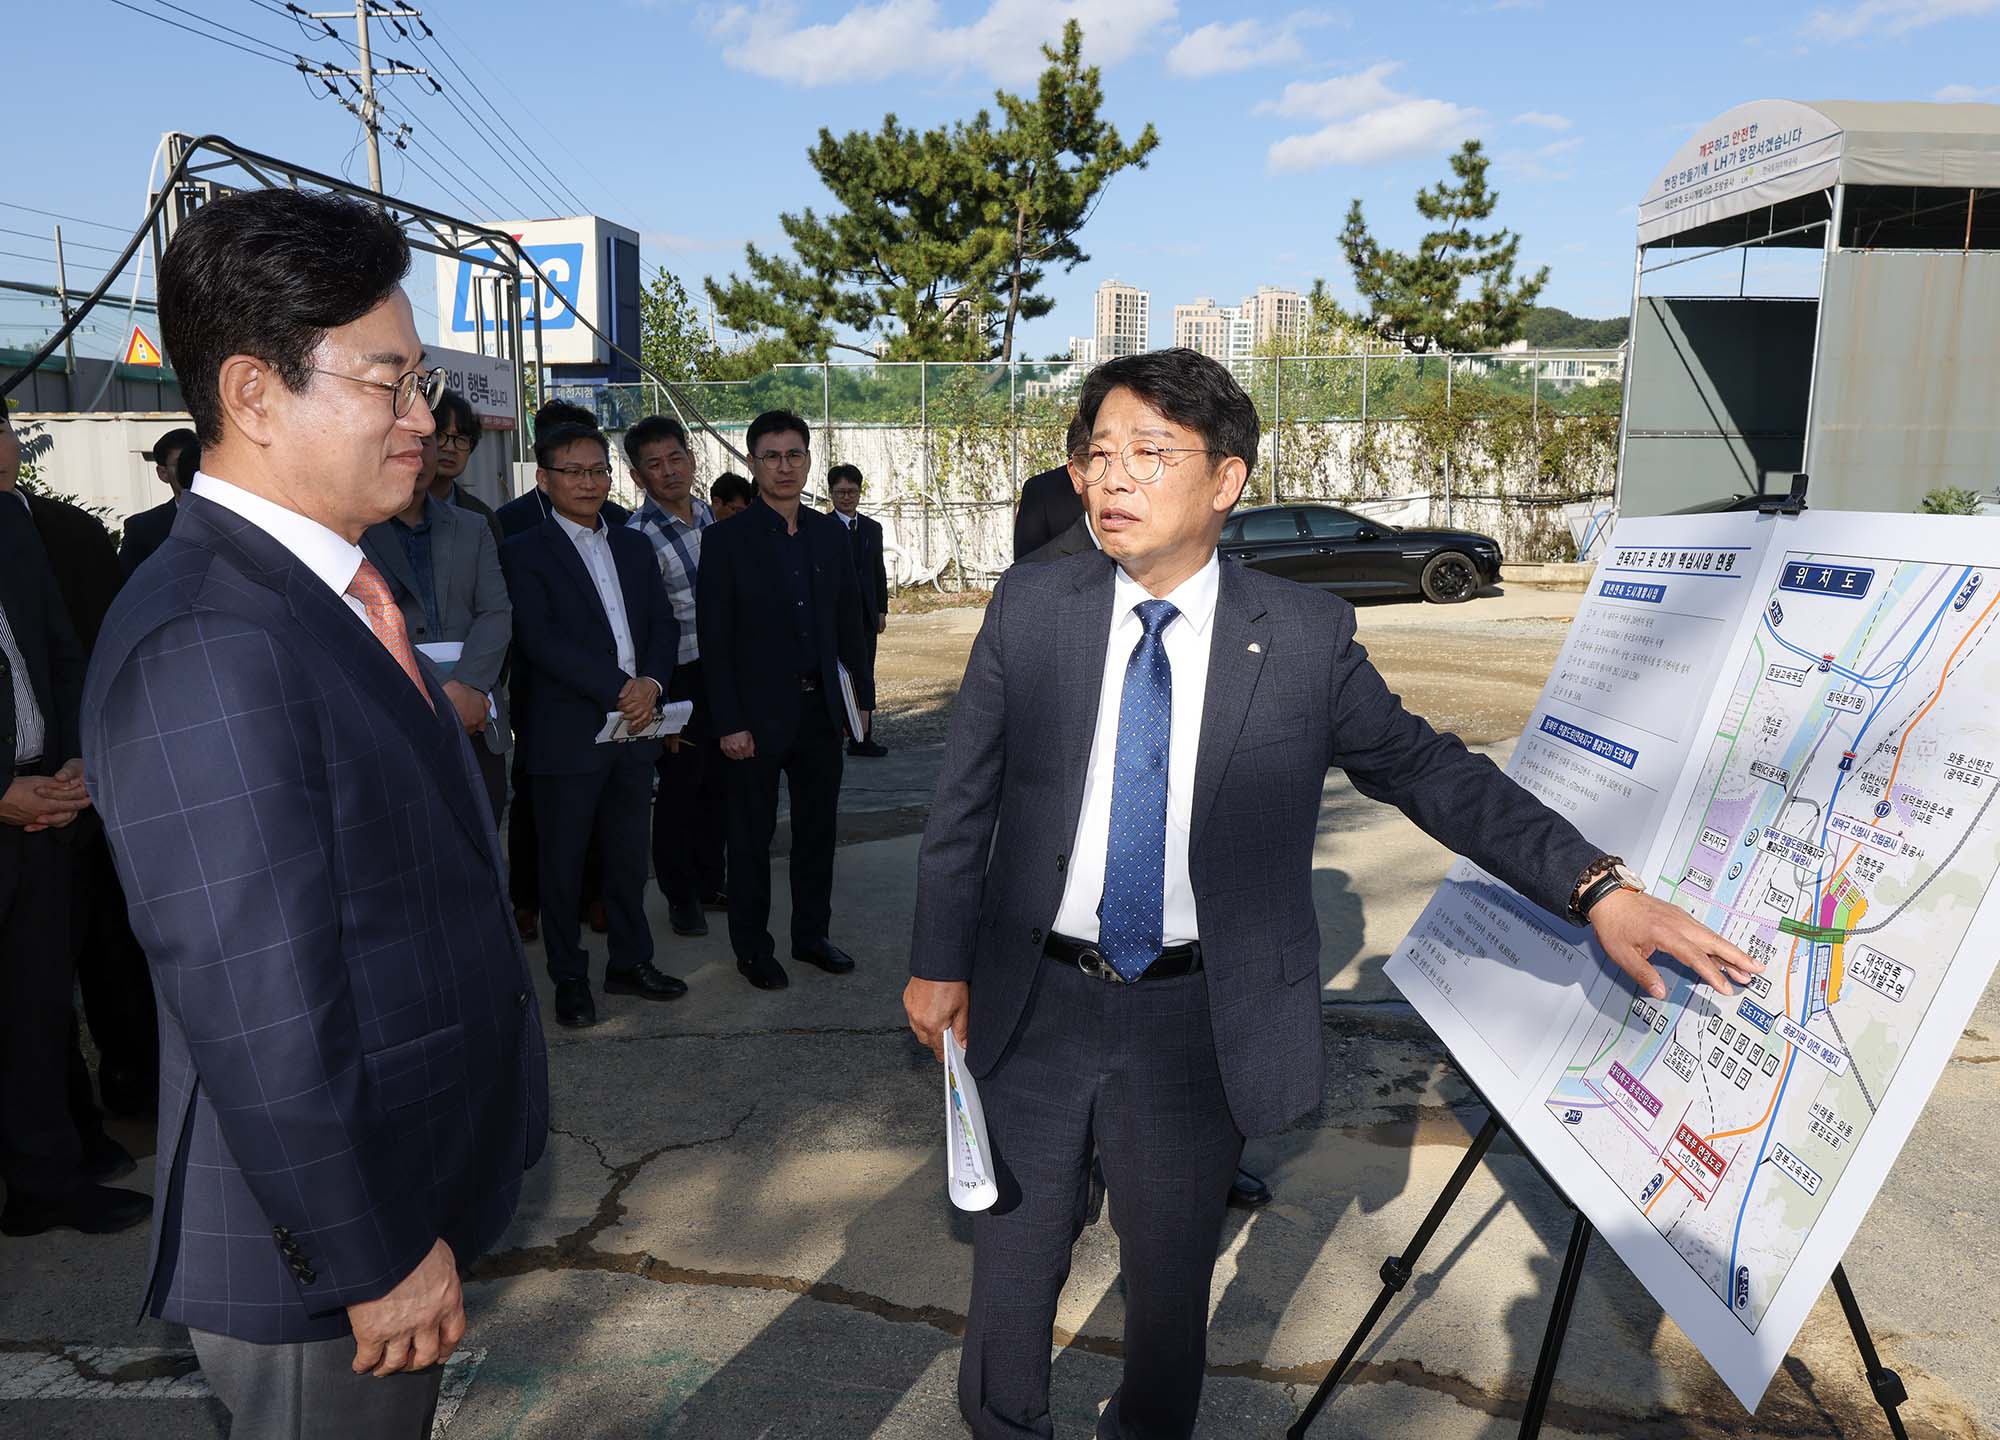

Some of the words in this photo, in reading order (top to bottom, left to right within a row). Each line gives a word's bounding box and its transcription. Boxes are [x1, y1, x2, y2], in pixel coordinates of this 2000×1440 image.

[1699, 135, 1732, 158] 깨끗하고
[1732, 122, 1758, 146] 안전한
[1664, 174, 1677, 192] 현장
[1679, 162, 1708, 186] 만들기에
[1714, 152, 1736, 171] LH가
[1739, 127, 1802, 162] 앞장서겠습니다
[467, 373, 508, 407] 행복입니다
[556, 387, 593, 399] 대전지점
[1616, 551, 1646, 566] 연축지구
[1647, 552, 1657, 568] 및
[1658, 552, 1676, 569] 연계
[1678, 553, 1713, 571] 핵심사업
[1715, 553, 1737, 572] 현황
[1768, 668, 1804, 683] 호남고속국도
[1827, 692, 1863, 709] 회덕분기점
[1761, 725, 1779, 737] 아파트
[1860, 784, 1881, 797] 아파트
[1943, 769, 1984, 789] (광역도로)
[1900, 793, 1954, 819] 대덕브라운스톤
[1910, 810, 1934, 825] 아파트
[1763, 828, 1780, 841] 동북부
[1831, 817, 1851, 832] 대덕구
[1852, 823, 1871, 840] 신청사
[1871, 830, 1899, 850] 건립공사
[1854, 866, 1877, 883] 아파트
[1856, 853, 1885, 874] 연축주공
[1770, 890, 1790, 908] 경부선
[1866, 952, 1903, 977] 대전연축
[1850, 960, 1905, 999] 도시개발구역
[1739, 1000, 1773, 1032] 국도17호선
[1782, 1022, 1809, 1046] 공공기관
[1807, 1037, 1821, 1057] 이전
[1819, 1046, 1842, 1069] 예정지
[1629, 1081, 1660, 1114] 동측진입도로
[1807, 1120, 1842, 1152] (혼잡도로)
[1678, 1129, 1699, 1149] 동북부
[1697, 1146, 1724, 1173] 연결도로
[1678, 1149, 1706, 1180] L=0.57km
[1777, 1148, 1818, 1190] 경부고속국도
